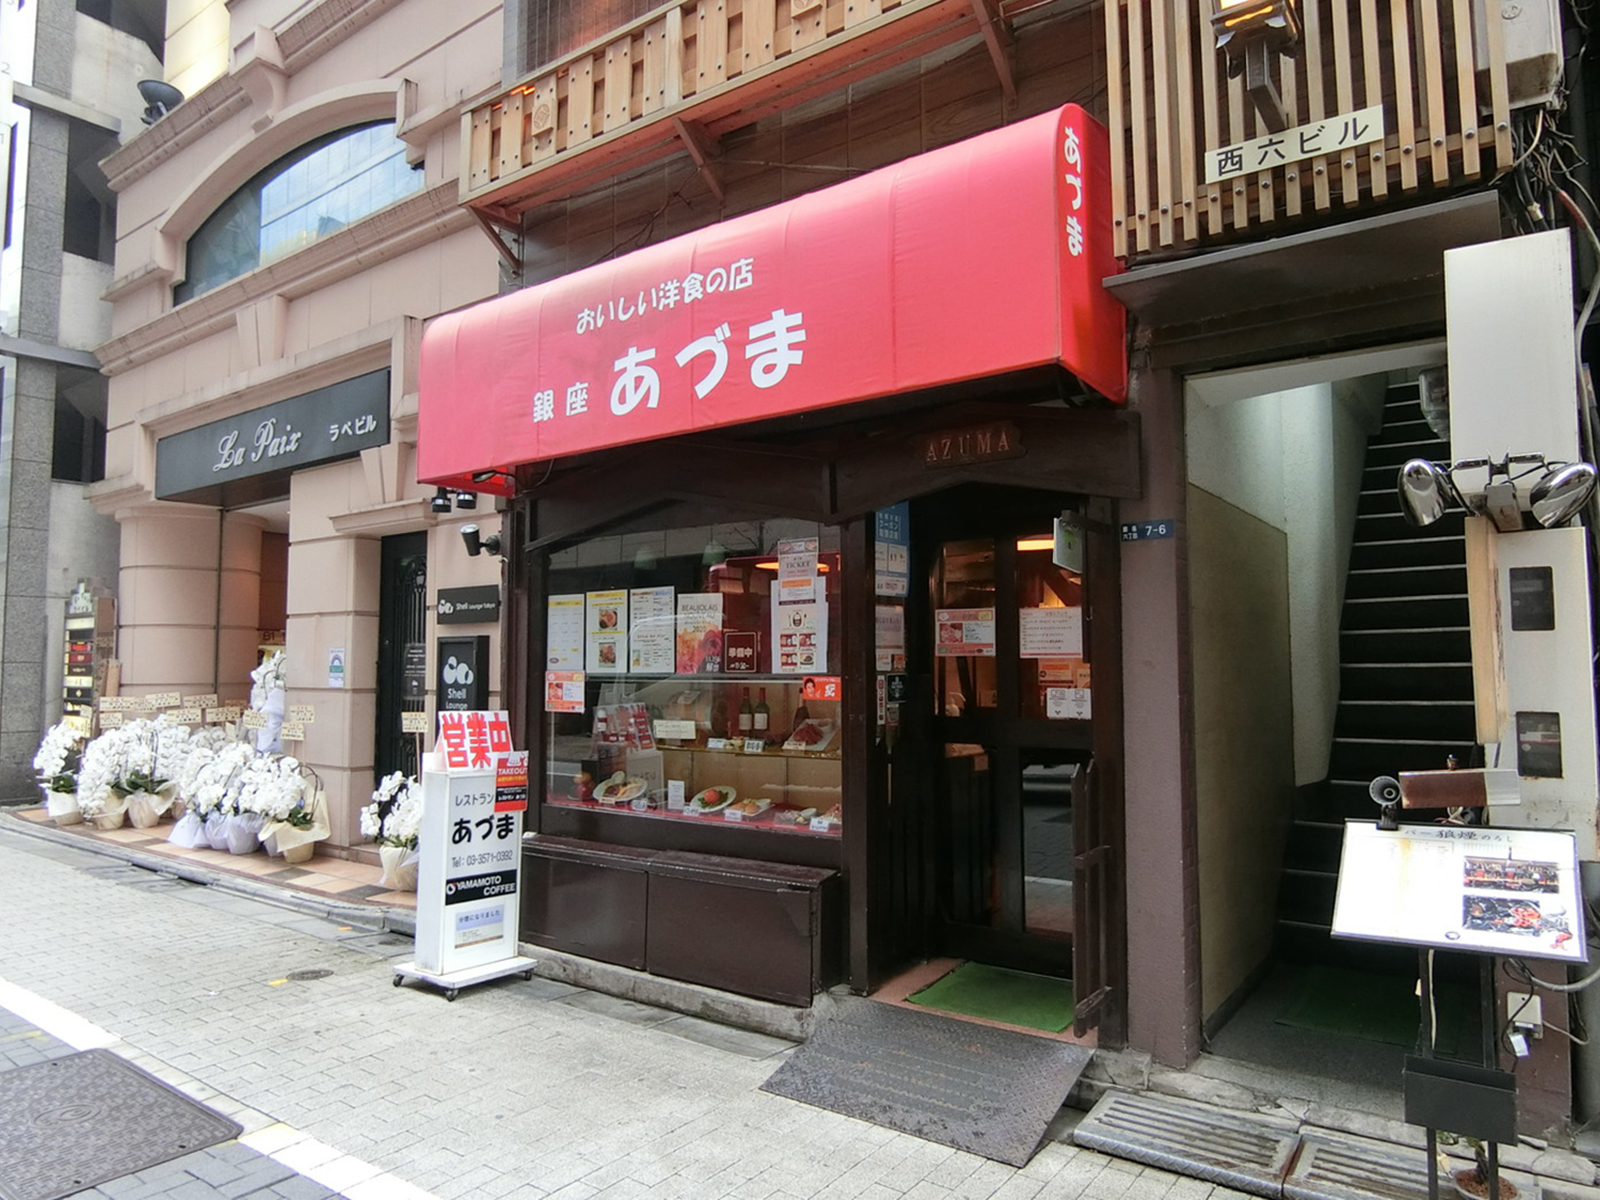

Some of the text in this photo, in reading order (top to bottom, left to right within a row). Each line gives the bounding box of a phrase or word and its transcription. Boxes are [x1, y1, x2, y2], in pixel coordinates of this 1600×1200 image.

[1216, 117, 1369, 176] 西六ビル
[1064, 126, 1083, 256] あづま
[576, 257, 754, 335] おいしい洋食の店
[533, 308, 806, 423] 銀座 あづま
[212, 418, 302, 471] La Paix
[926, 430, 1010, 462] AZUMA
[1145, 524, 1166, 536] 7-6
[456, 602, 469, 611] Shell
[447, 688, 467, 699] Shell
[445, 701, 468, 711] Lounge
[441, 712, 511, 768] 営業中
[498, 767, 528, 776] TAKEOUT
[455, 793, 494, 807] レストラン
[452, 813, 515, 844] あづま
[457, 875, 502, 890] YAMAMOTO
[483, 882, 516, 897] COFFEE
